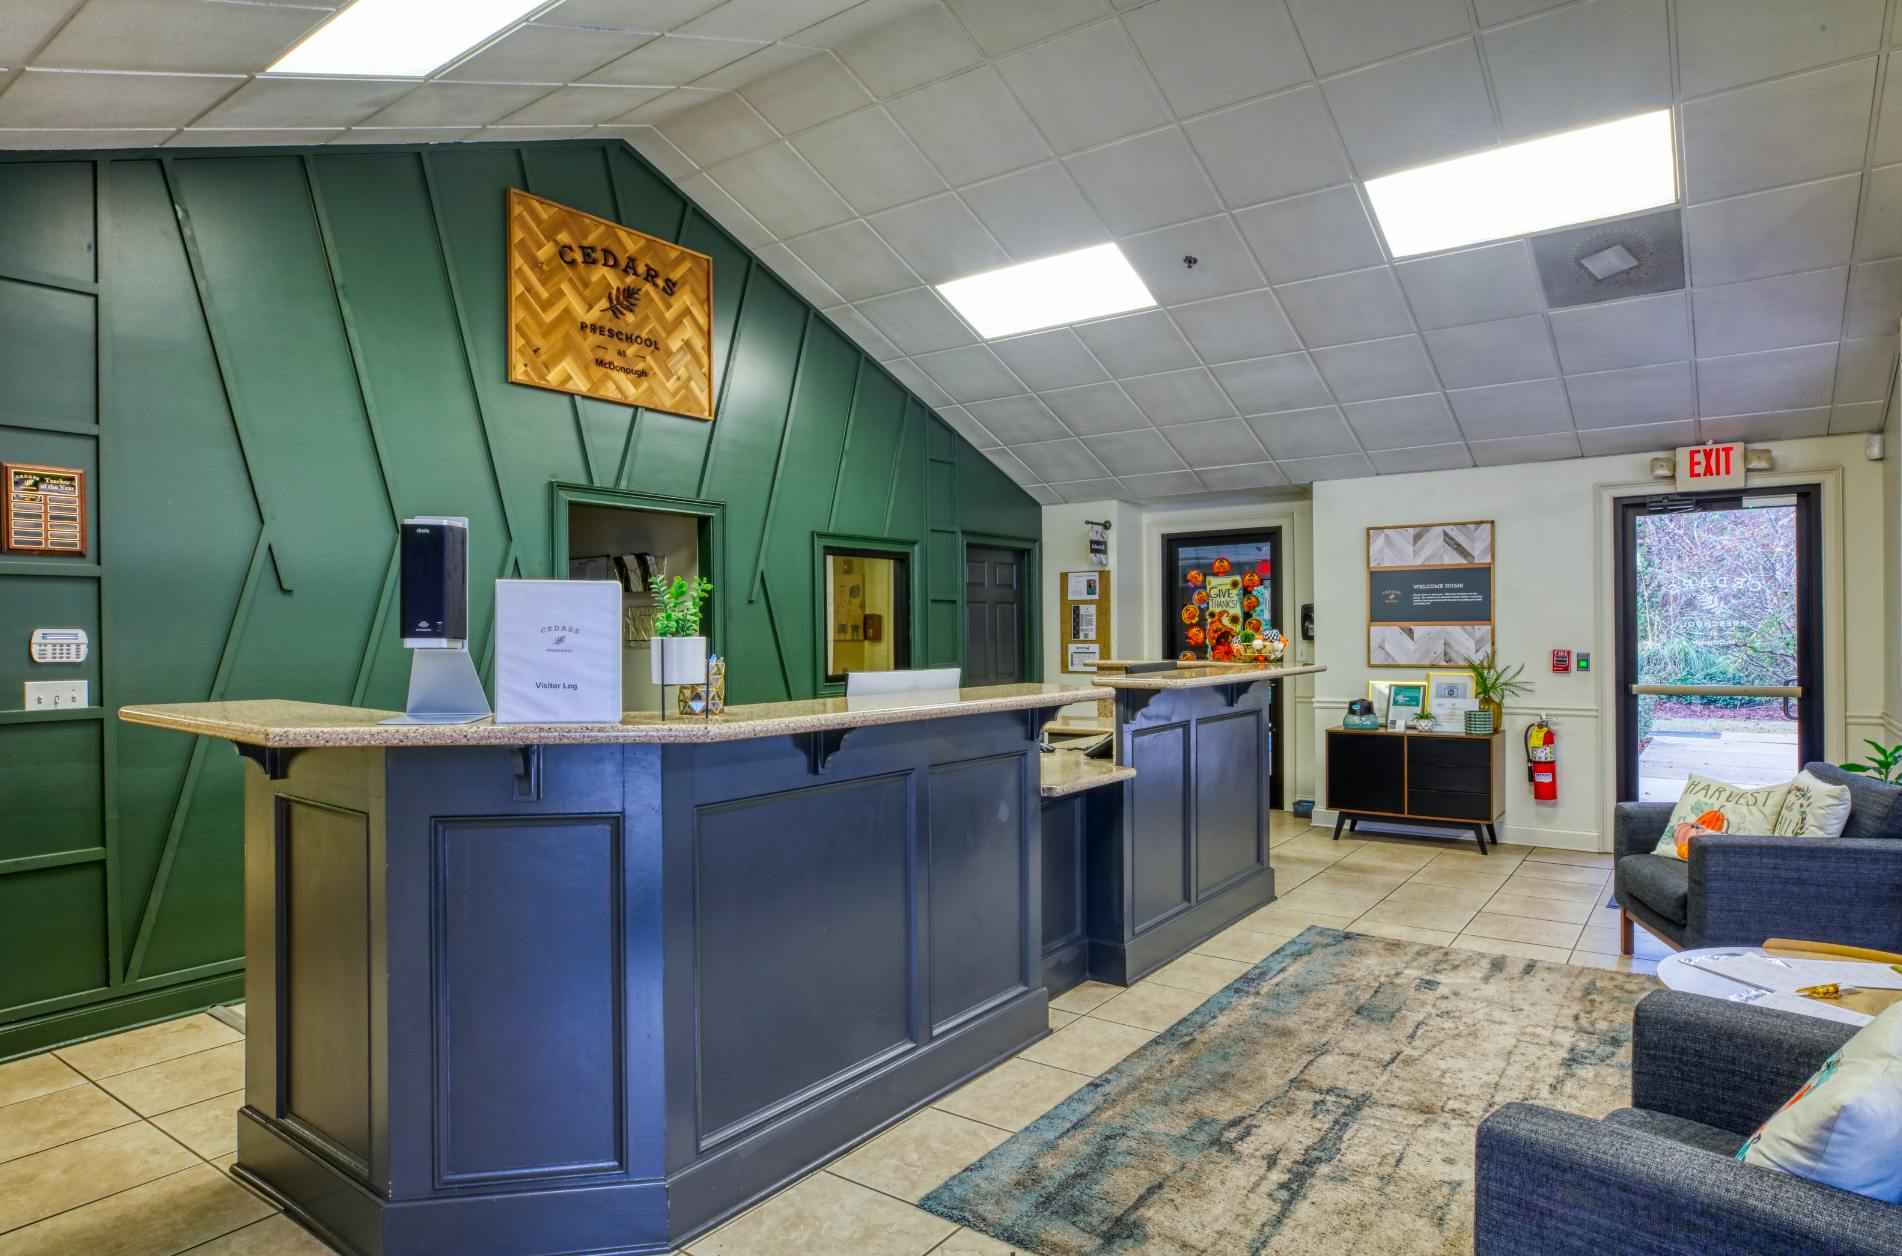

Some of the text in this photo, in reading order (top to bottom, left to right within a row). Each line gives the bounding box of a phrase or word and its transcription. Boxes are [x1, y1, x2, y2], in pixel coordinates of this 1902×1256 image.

[559, 245, 677, 297] CEDARS
[580, 321, 660, 351] PRESCHOOL
[617, 349, 626, 357] at
[595, 359, 649, 378] McDonough
[1689, 446, 1734, 478] EXIT
[44, 477, 71, 485] Teacher
[1209, 586, 1234, 599] GIVE
[1210, 599, 1238, 609] THANKS!
[540, 625, 580, 634] CEDARS
[563, 682, 578, 691] Log
[1684, 779, 1776, 808] HARVEST
